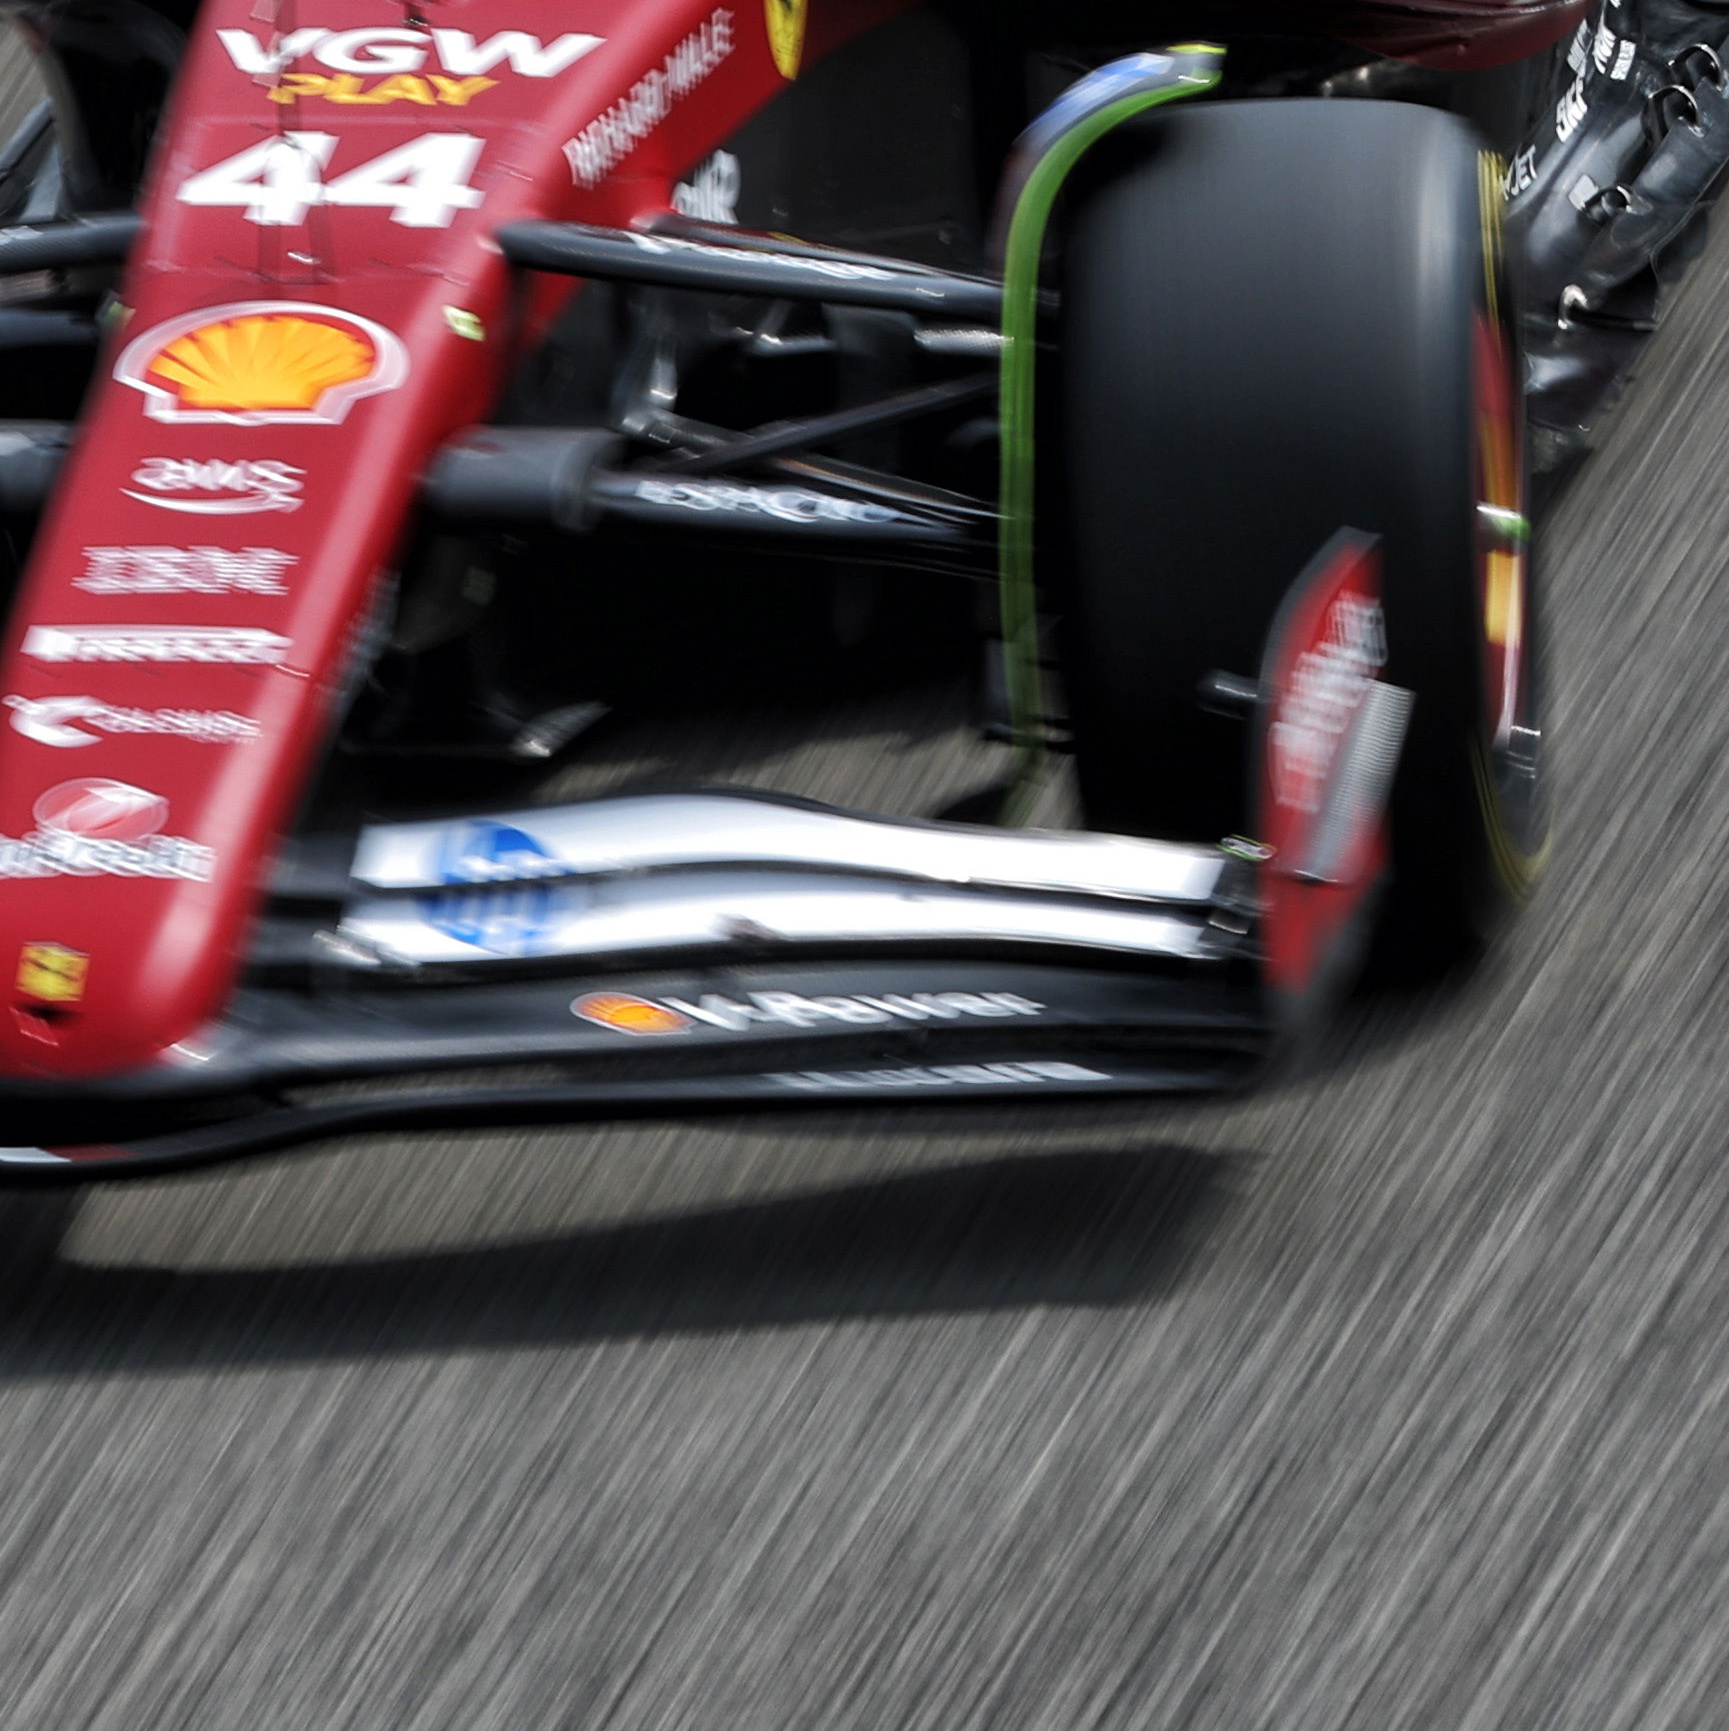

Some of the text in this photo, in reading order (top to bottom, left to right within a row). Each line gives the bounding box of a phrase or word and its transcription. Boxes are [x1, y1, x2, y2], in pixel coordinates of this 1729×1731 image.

[216, 27, 607, 78] VGW
[268, 72, 501, 105] PLAY
[175, 131, 489, 228] 44
